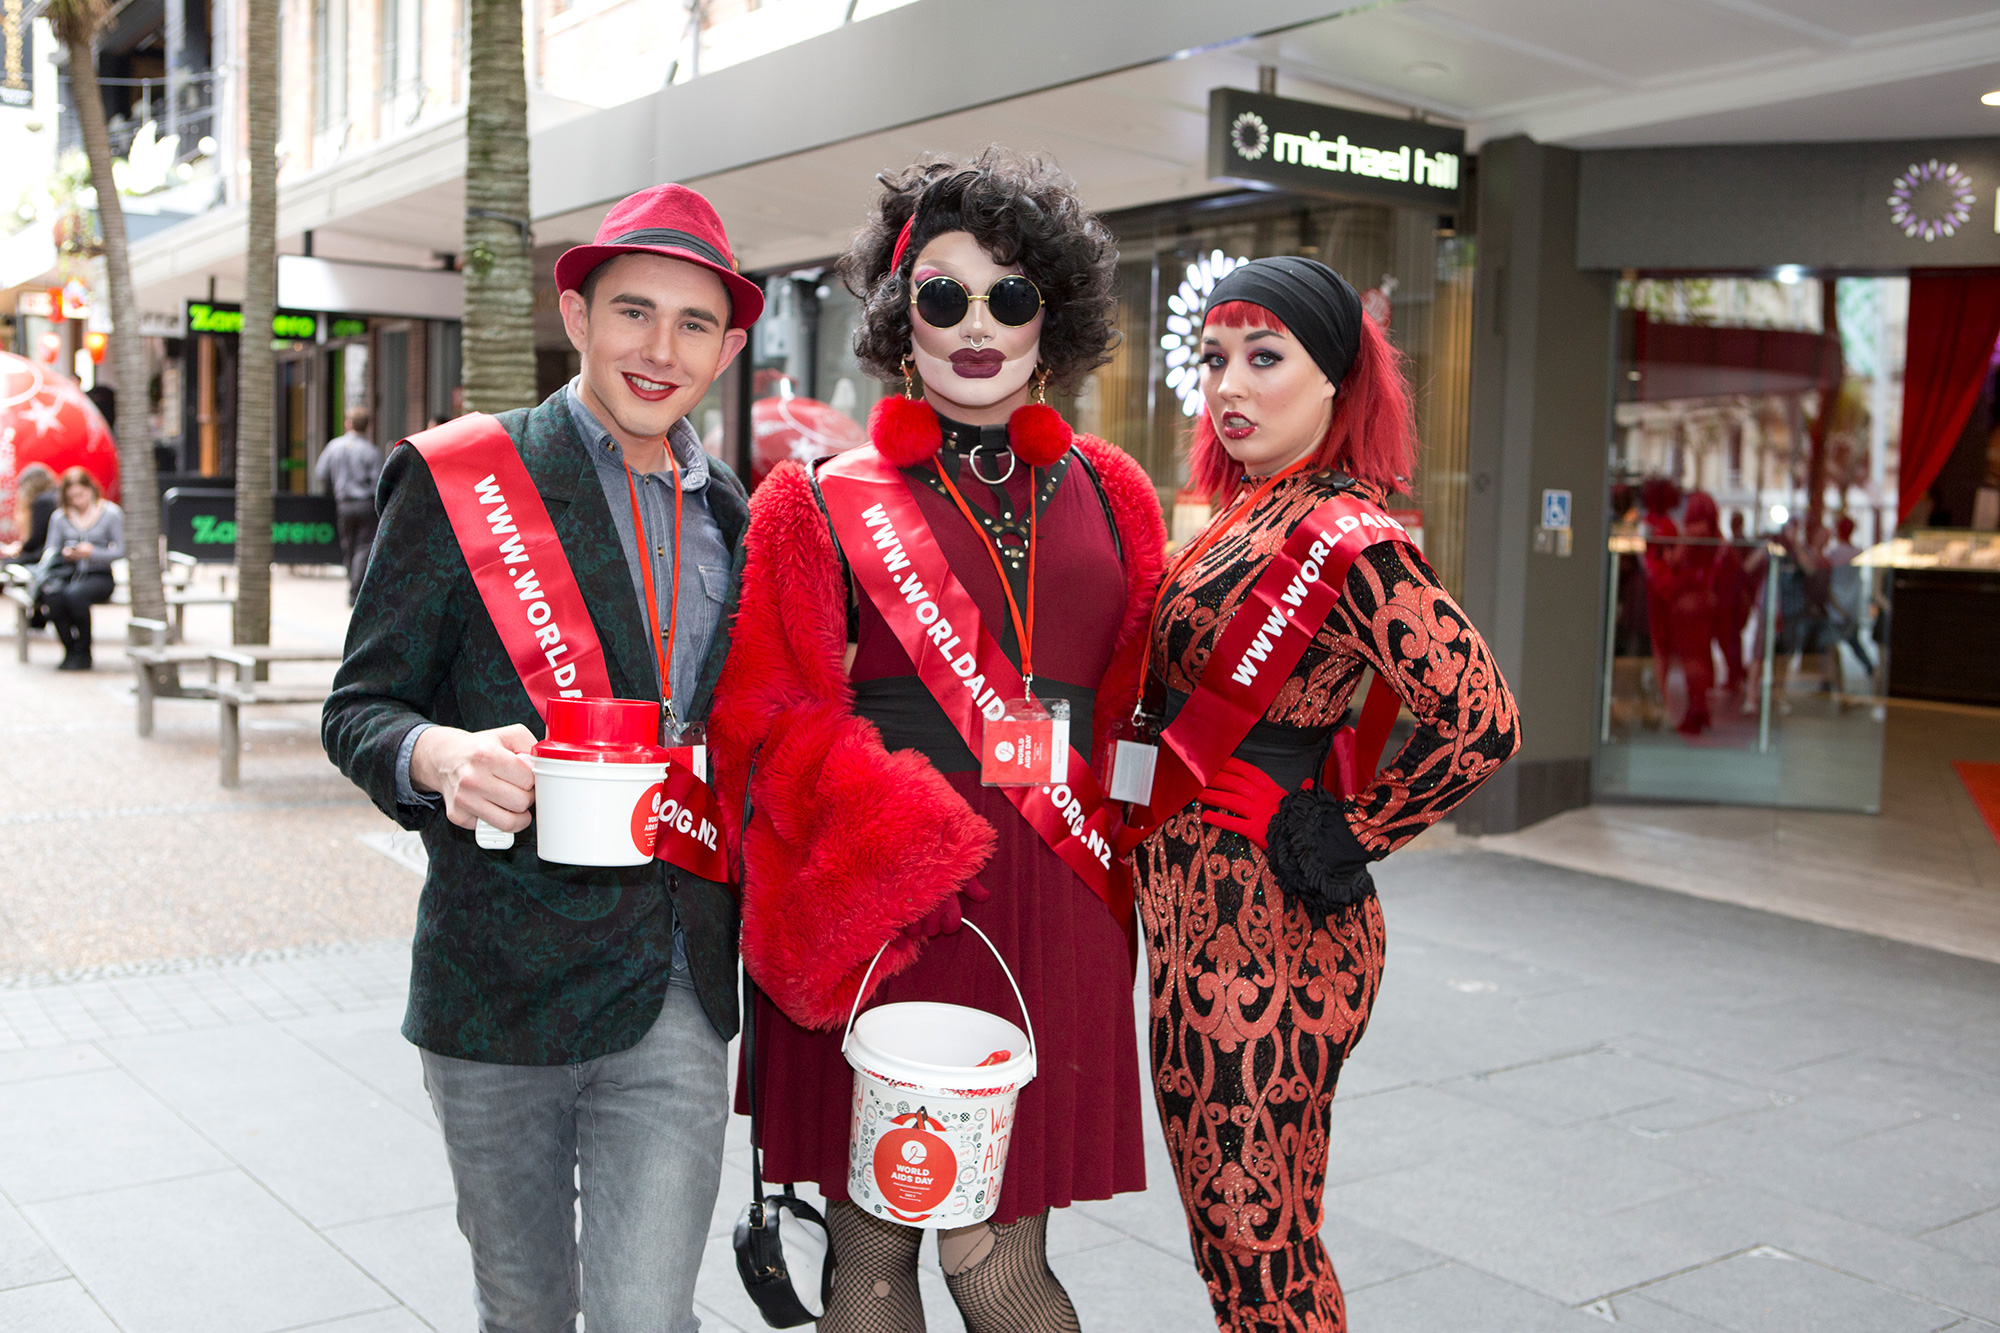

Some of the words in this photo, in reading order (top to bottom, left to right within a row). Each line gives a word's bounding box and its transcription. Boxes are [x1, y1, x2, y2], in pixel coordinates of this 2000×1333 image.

[1273, 131, 1410, 182] michael
[1413, 148, 1459, 189] hill
[191, 515, 335, 544] Zarero
[1231, 512, 1415, 687] WWW.WORLDAID
[1017, 737, 1025, 766] WORLD
[1024, 734, 1032, 750] DAY
[1024, 750, 1032, 769] AIDS
[658, 798, 718, 852] OG.NZ
[890, 1171, 914, 1183] AIDS
[914, 1176, 934, 1185] DAY
[896, 1164, 930, 1177] WORLD
